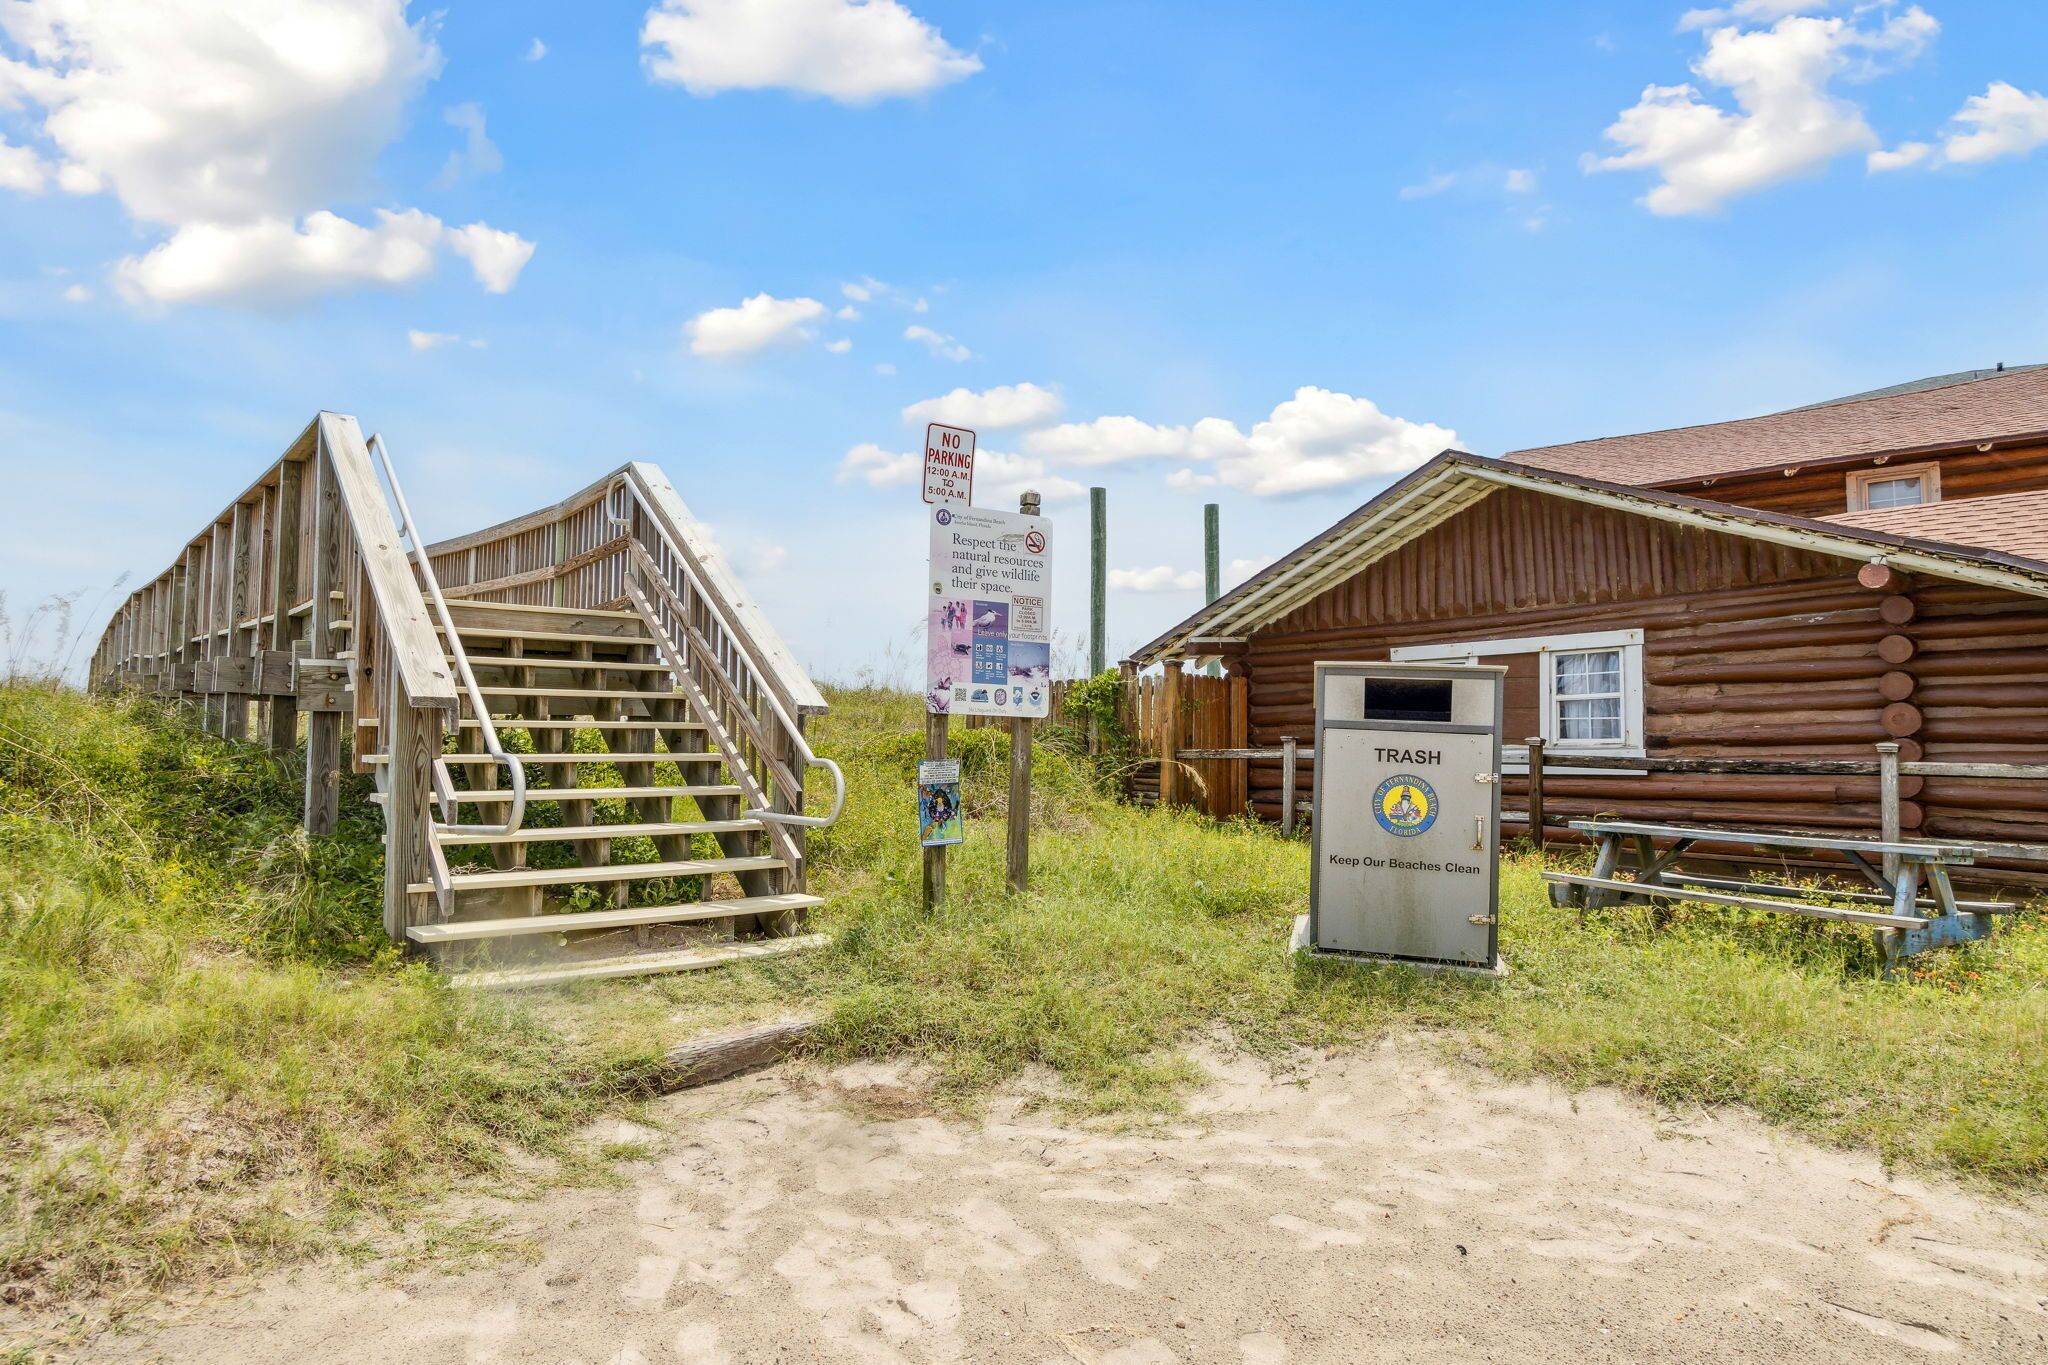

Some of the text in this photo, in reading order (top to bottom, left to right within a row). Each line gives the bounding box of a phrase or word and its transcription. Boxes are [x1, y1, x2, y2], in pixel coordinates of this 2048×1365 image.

[942, 432, 960, 449] NO
[928, 447, 971, 469] PARKING
[927, 466, 970, 481] 12:00 A.M.
[942, 478, 954, 487] TO
[928, 486, 967, 500] 5:00 A.M.
[952, 533, 1017, 552] Respect the
[952, 550, 1044, 568] natural resources
[951, 563, 1040, 582] and give wildlife
[951, 576, 1013, 594] their space.
[1013, 597, 1042, 606] NOTICE
[978, 629, 995, 637] Leave
[1374, 748, 1441, 765] TRASH
[1377, 786, 1385, 796] OF
[1385, 776, 1429, 793] FERNANDINA
[1428, 793, 1436, 817] BEACH
[1390, 825, 1421, 836] FLORIDA
[1329, 854, 1480, 875] Keep Our Beaches Clean
